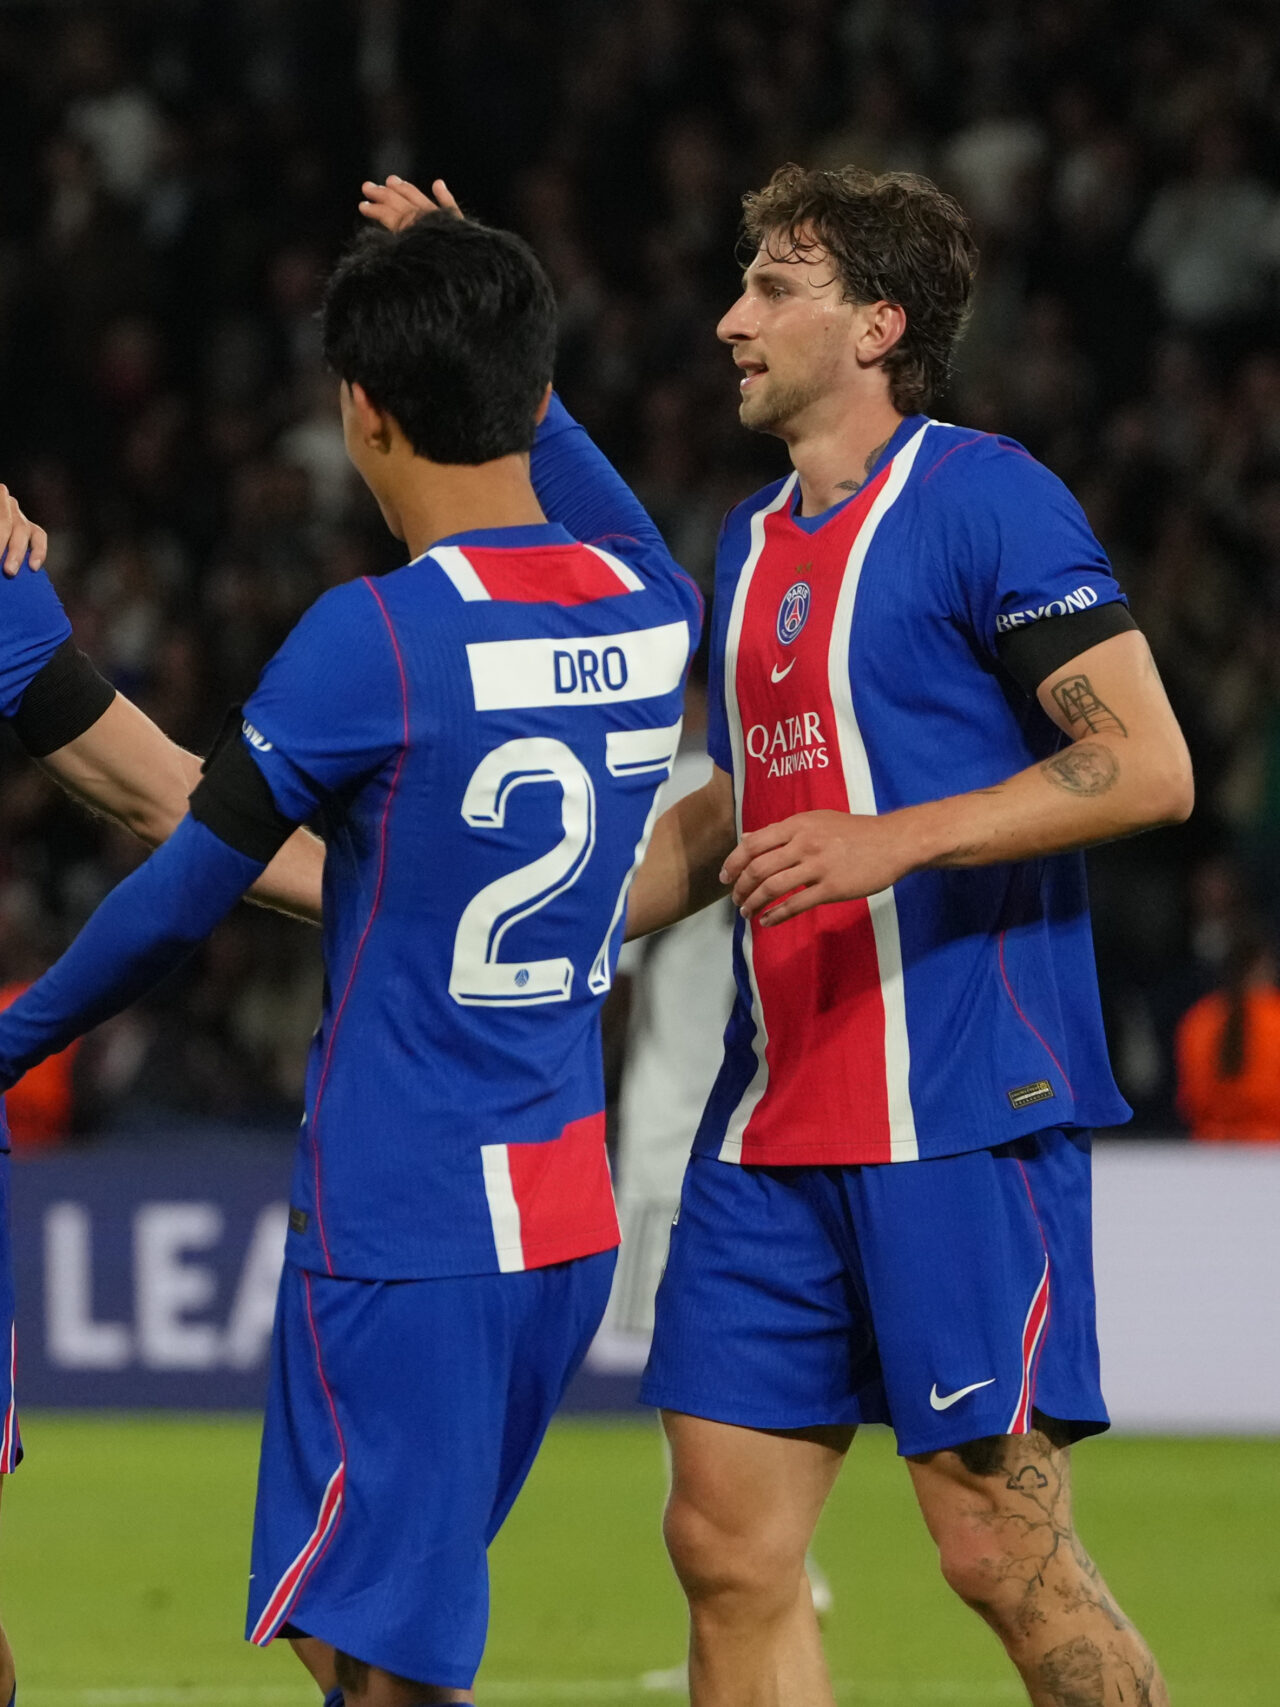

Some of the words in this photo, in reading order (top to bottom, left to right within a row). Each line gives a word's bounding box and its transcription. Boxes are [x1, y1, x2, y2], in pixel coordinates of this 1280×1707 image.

[786, 586, 808, 603] PARIS
[996, 585, 1098, 632] BEYOND
[553, 646, 628, 694] DRO
[746, 711, 826, 764] QATAR
[767, 746, 830, 779] AIRWAYS
